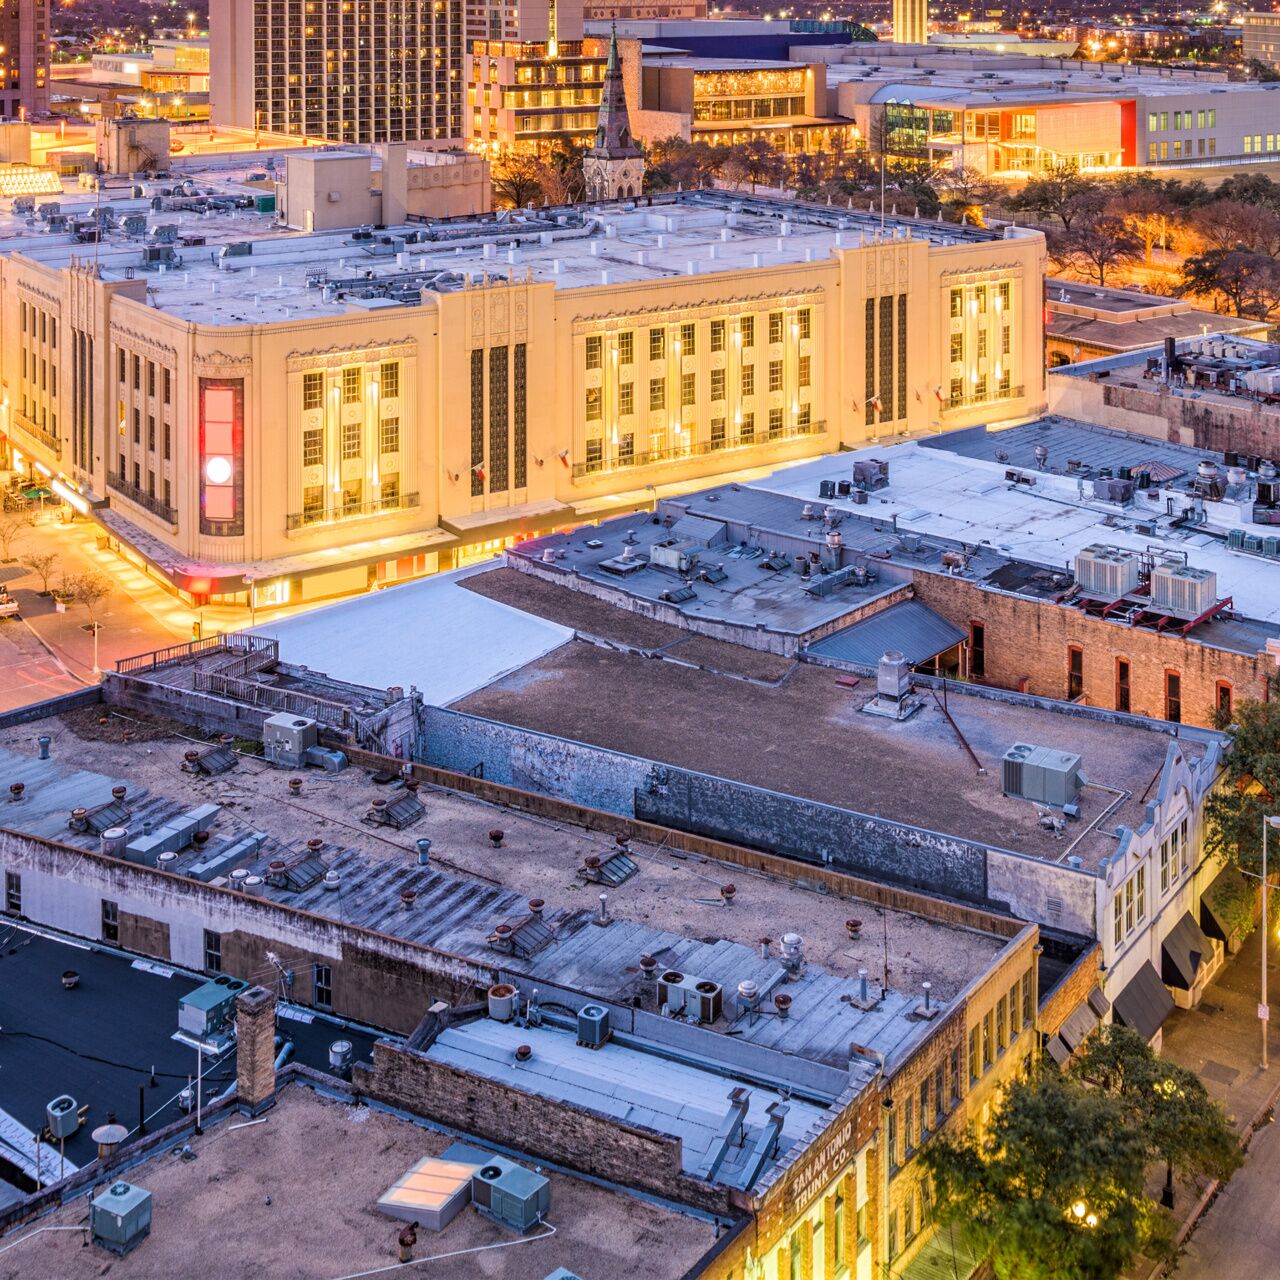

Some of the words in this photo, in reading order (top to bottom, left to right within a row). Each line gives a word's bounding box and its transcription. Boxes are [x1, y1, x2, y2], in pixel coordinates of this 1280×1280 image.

[793, 1164, 812, 1197] SAN
[814, 1121, 852, 1175] ANTONIO
[795, 1166, 829, 1213] TRUNK
[832, 1148, 850, 1171] CO.
